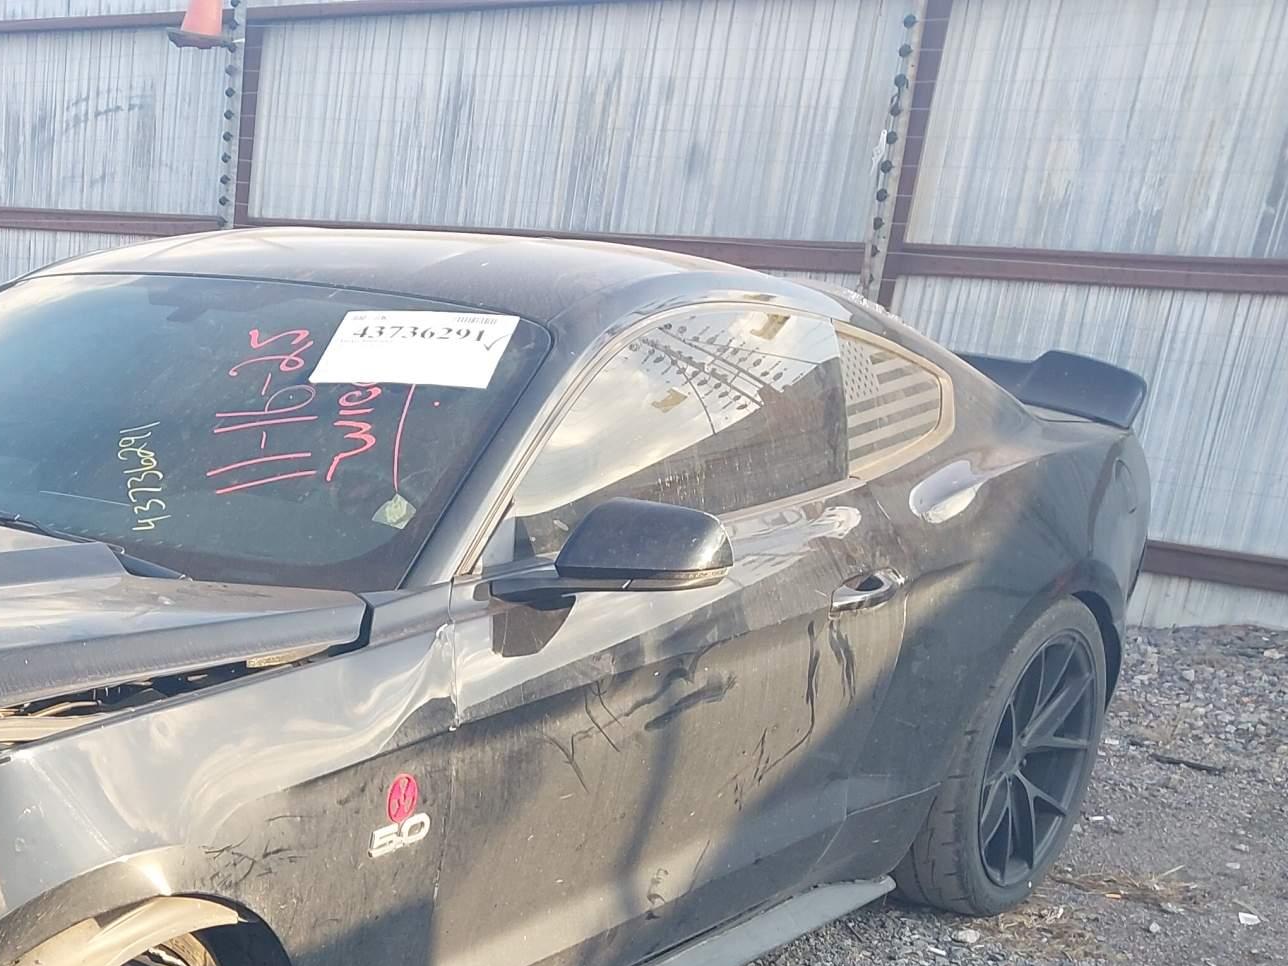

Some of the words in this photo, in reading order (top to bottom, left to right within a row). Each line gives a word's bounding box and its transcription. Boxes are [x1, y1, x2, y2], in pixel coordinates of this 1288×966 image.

[353, 326, 485, 342] 43736291
[206, 328, 319, 495] 11-16-25
[326, 381, 383, 483] WIC
[117, 421, 172, 531] 43736291
